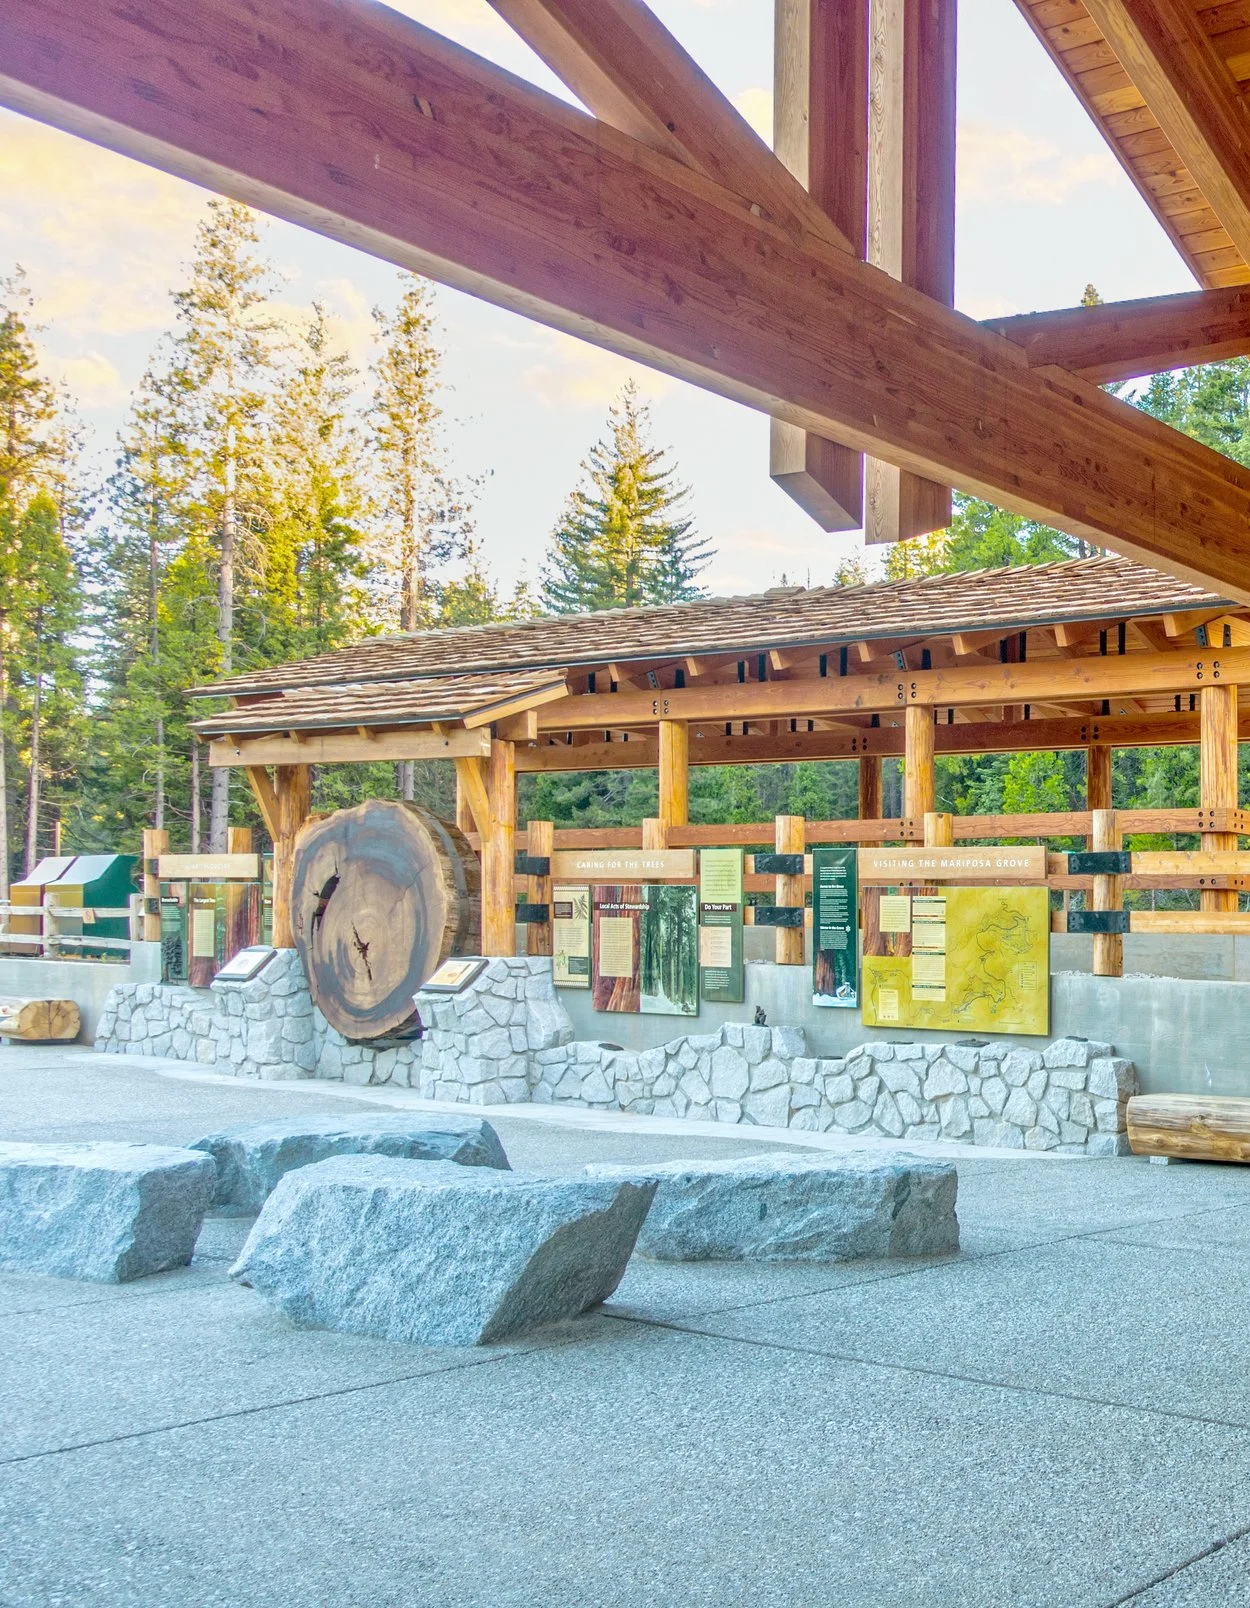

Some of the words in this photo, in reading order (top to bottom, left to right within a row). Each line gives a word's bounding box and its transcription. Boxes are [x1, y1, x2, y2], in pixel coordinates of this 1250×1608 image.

[576, 860, 605, 869] CARING
[607, 860, 622, 869] FOR
[625, 860, 638, 869] THE
[642, 860, 665, 869] TREES
[873, 859, 914, 868] VISITING
[919, 859, 936, 868] THE
[940, 859, 991, 868] MARIPOSA
[996, 859, 1029, 868] GROVE
